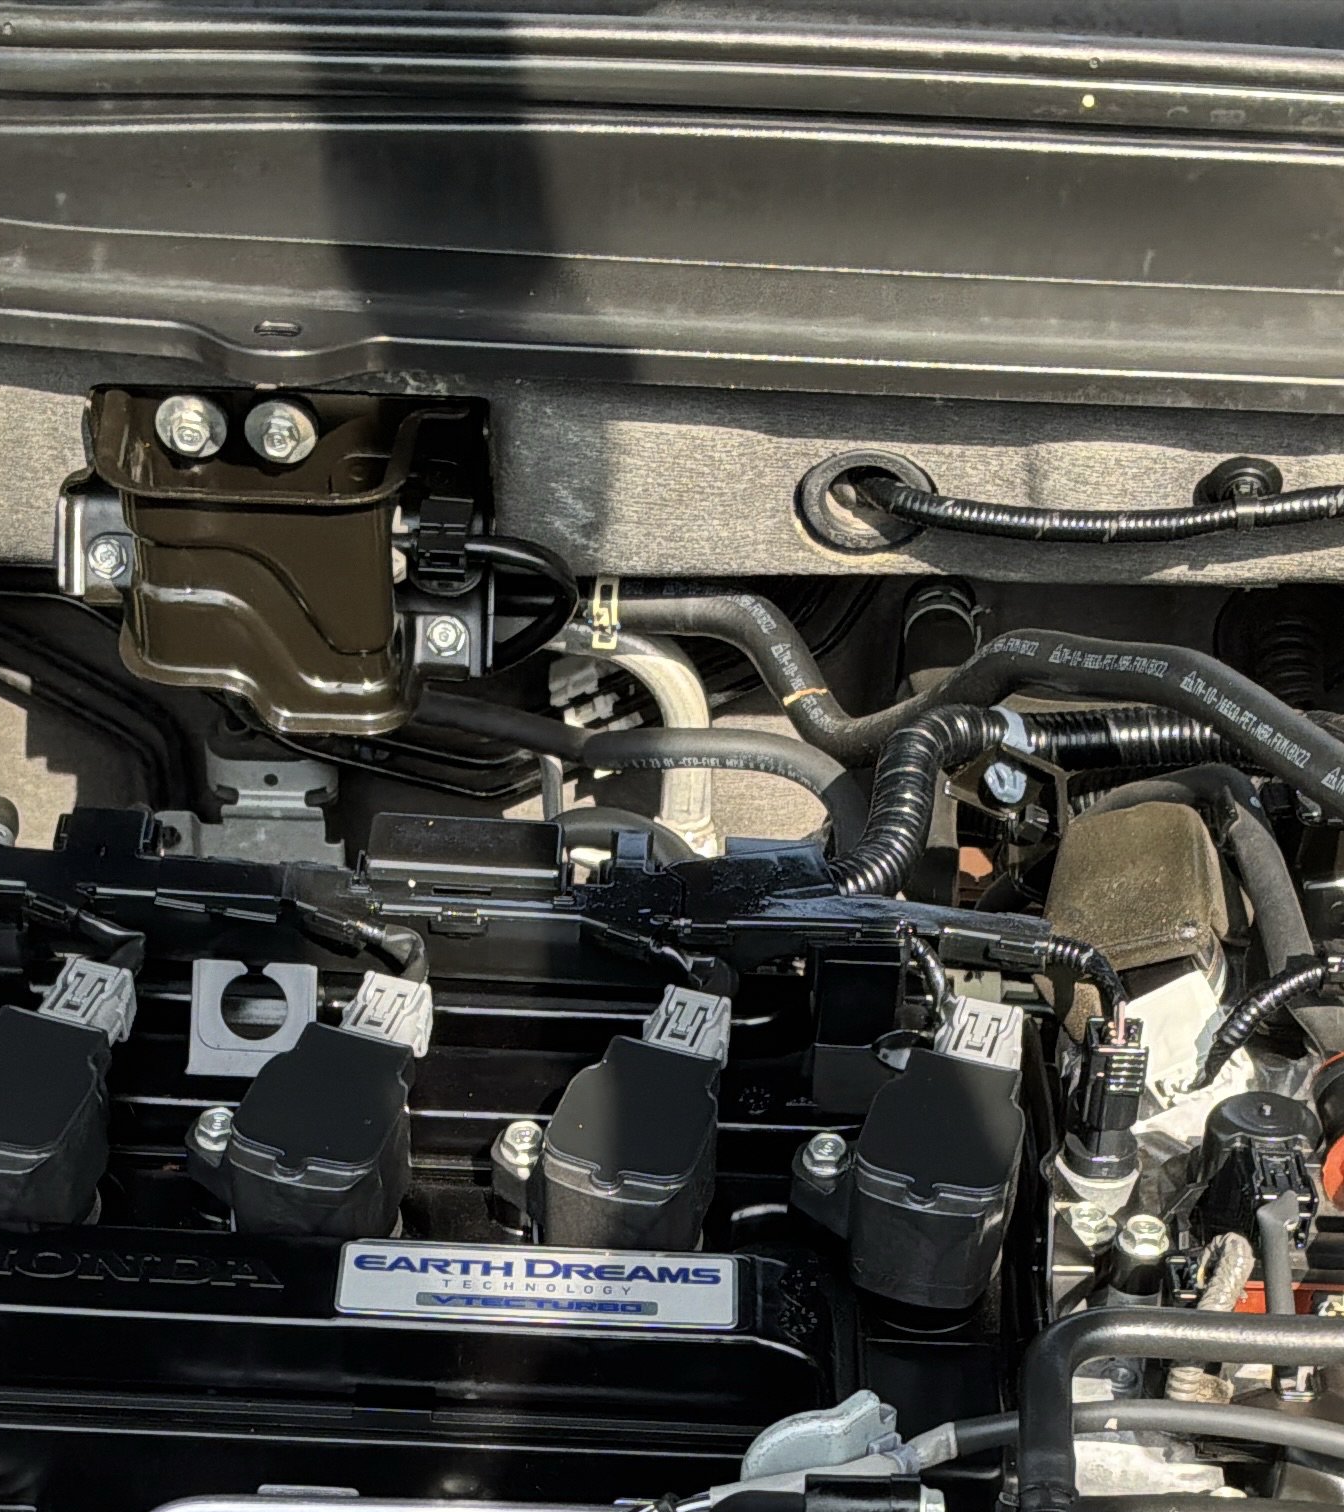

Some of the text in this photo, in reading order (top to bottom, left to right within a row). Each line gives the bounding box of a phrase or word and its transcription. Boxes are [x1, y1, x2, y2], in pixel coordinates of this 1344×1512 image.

[353, 1254, 722, 1286] EARTH DREAMS
[442, 1278, 633, 1297] TECHNOLOGY
